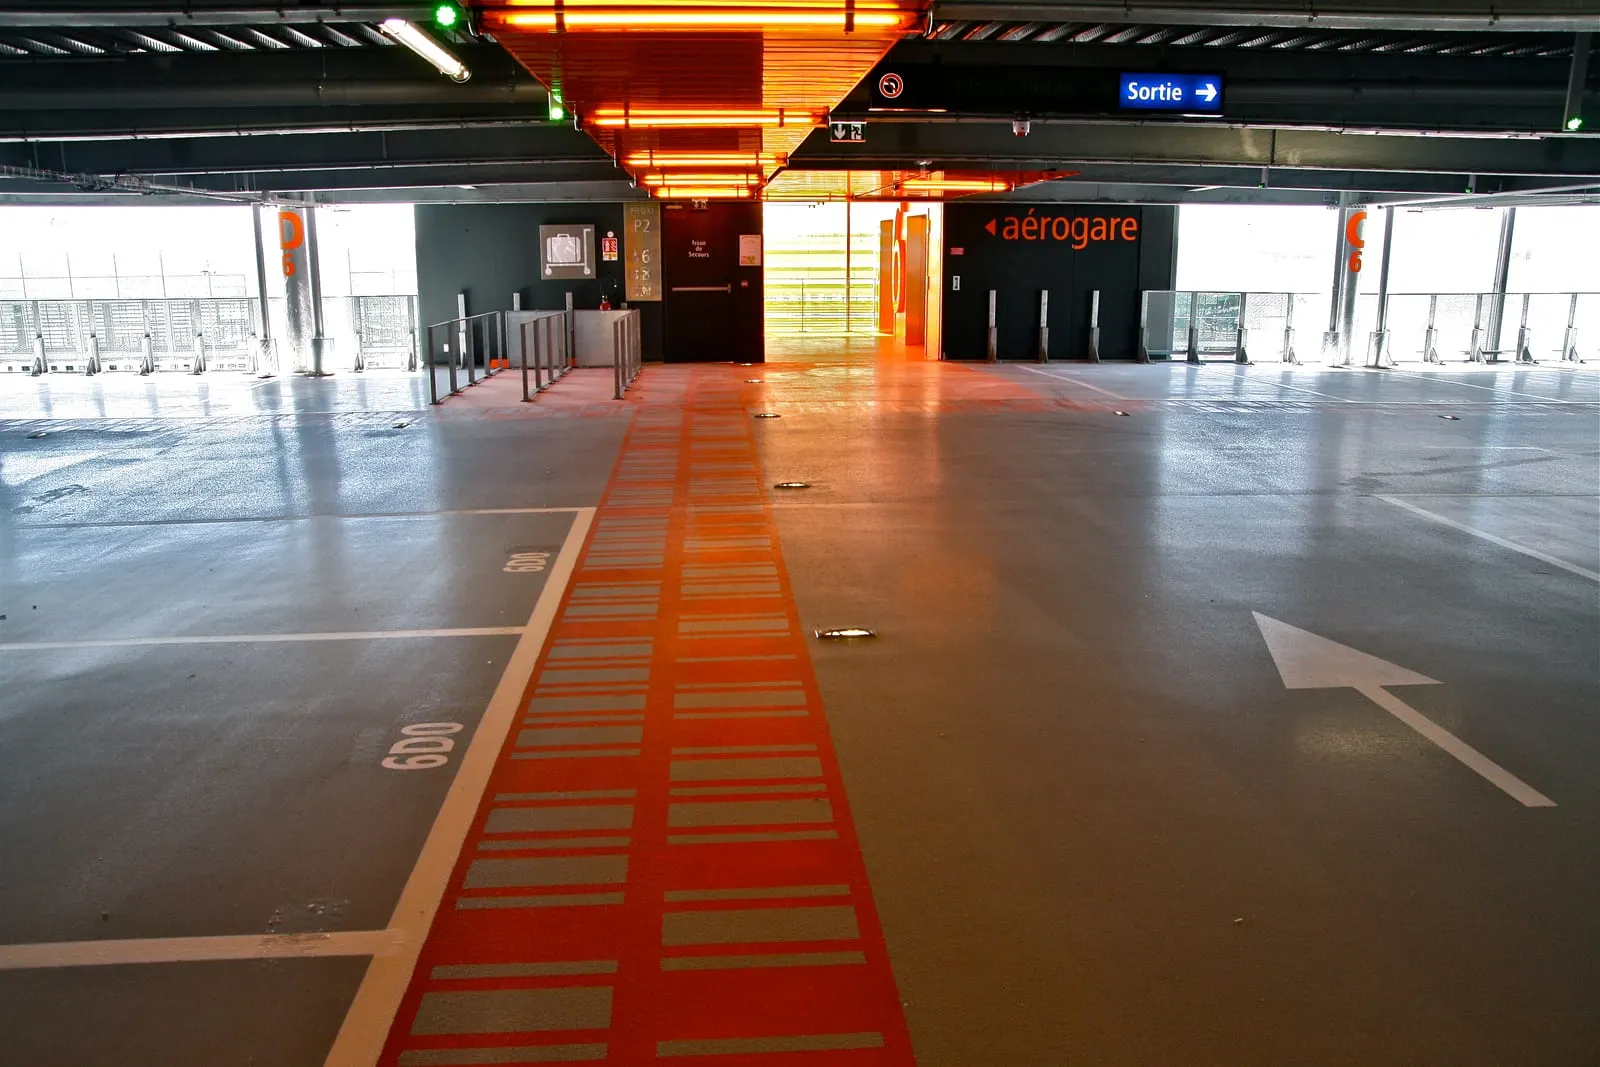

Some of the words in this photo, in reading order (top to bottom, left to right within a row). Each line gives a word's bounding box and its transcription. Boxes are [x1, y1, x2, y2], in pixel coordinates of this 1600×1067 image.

[1128, 82, 1182, 102] Sortie
[278, 211, 304, 250] D
[634, 219, 650, 233] P2
[1002, 208, 1138, 249] aérogare
[1346, 211, 1367, 248] C
[282, 253, 296, 277] 6
[641, 249, 650, 264] 6
[1349, 251, 1362, 273] 6
